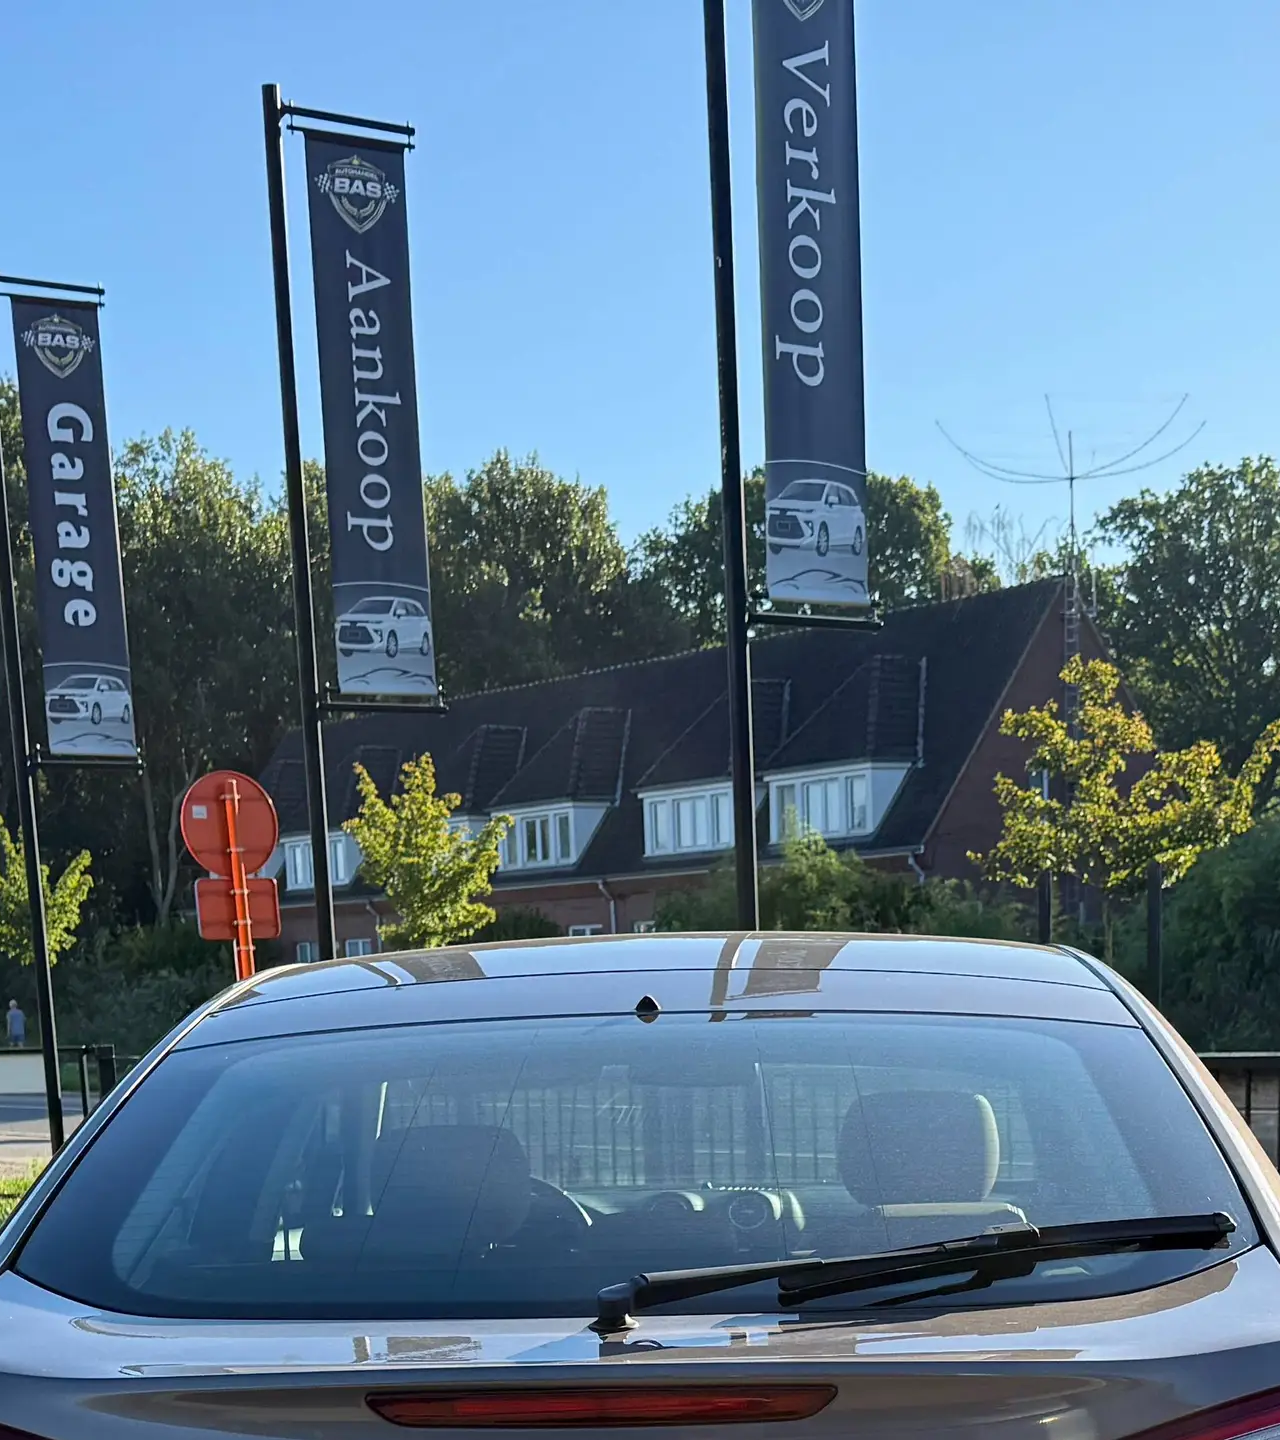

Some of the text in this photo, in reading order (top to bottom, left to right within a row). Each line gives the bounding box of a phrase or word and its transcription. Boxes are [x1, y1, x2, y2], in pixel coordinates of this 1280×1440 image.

[334, 178, 382, 198] BAS
[775, 40, 836, 387] Verkoop
[38, 333, 80, 350] BAS
[345, 249, 401, 551] Aankoop
[47, 402, 97, 627] Garage
